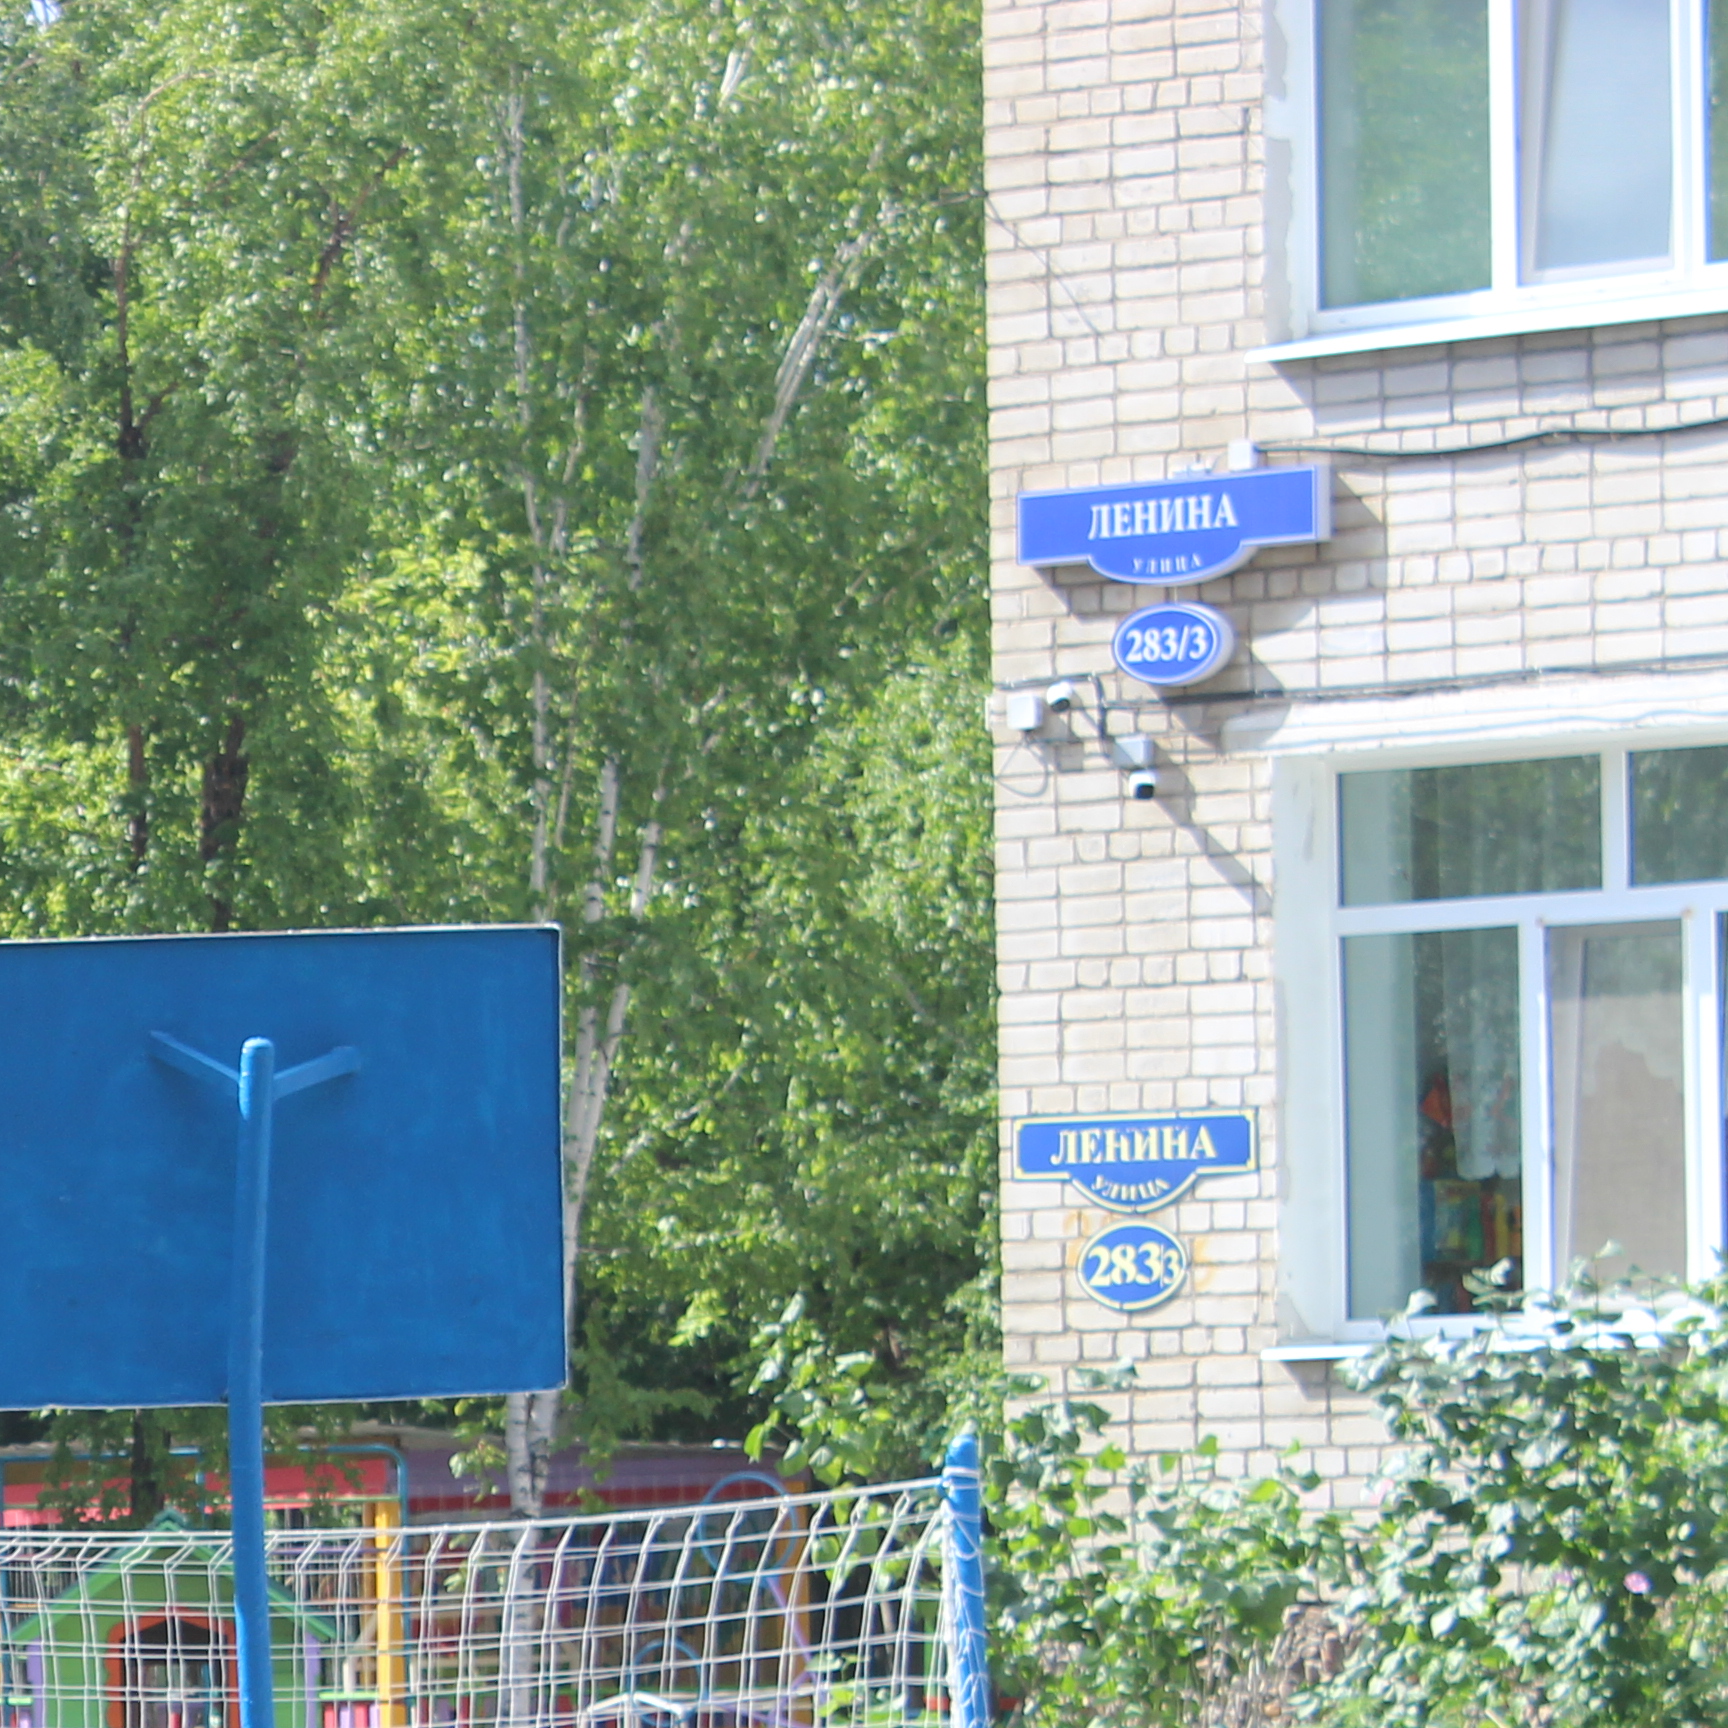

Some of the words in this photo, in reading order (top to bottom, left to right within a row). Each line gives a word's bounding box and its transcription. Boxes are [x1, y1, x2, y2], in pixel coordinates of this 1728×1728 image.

[1087, 493, 1238, 540] ЛЕНИНА
[1132, 553, 1201, 574] УЛИЦА
[1125, 625, 1208, 662] 283/3
[1050, 1125, 1217, 1165] ЛЕНИНА
[1092, 1174, 1170, 1200] УЛИЦА
